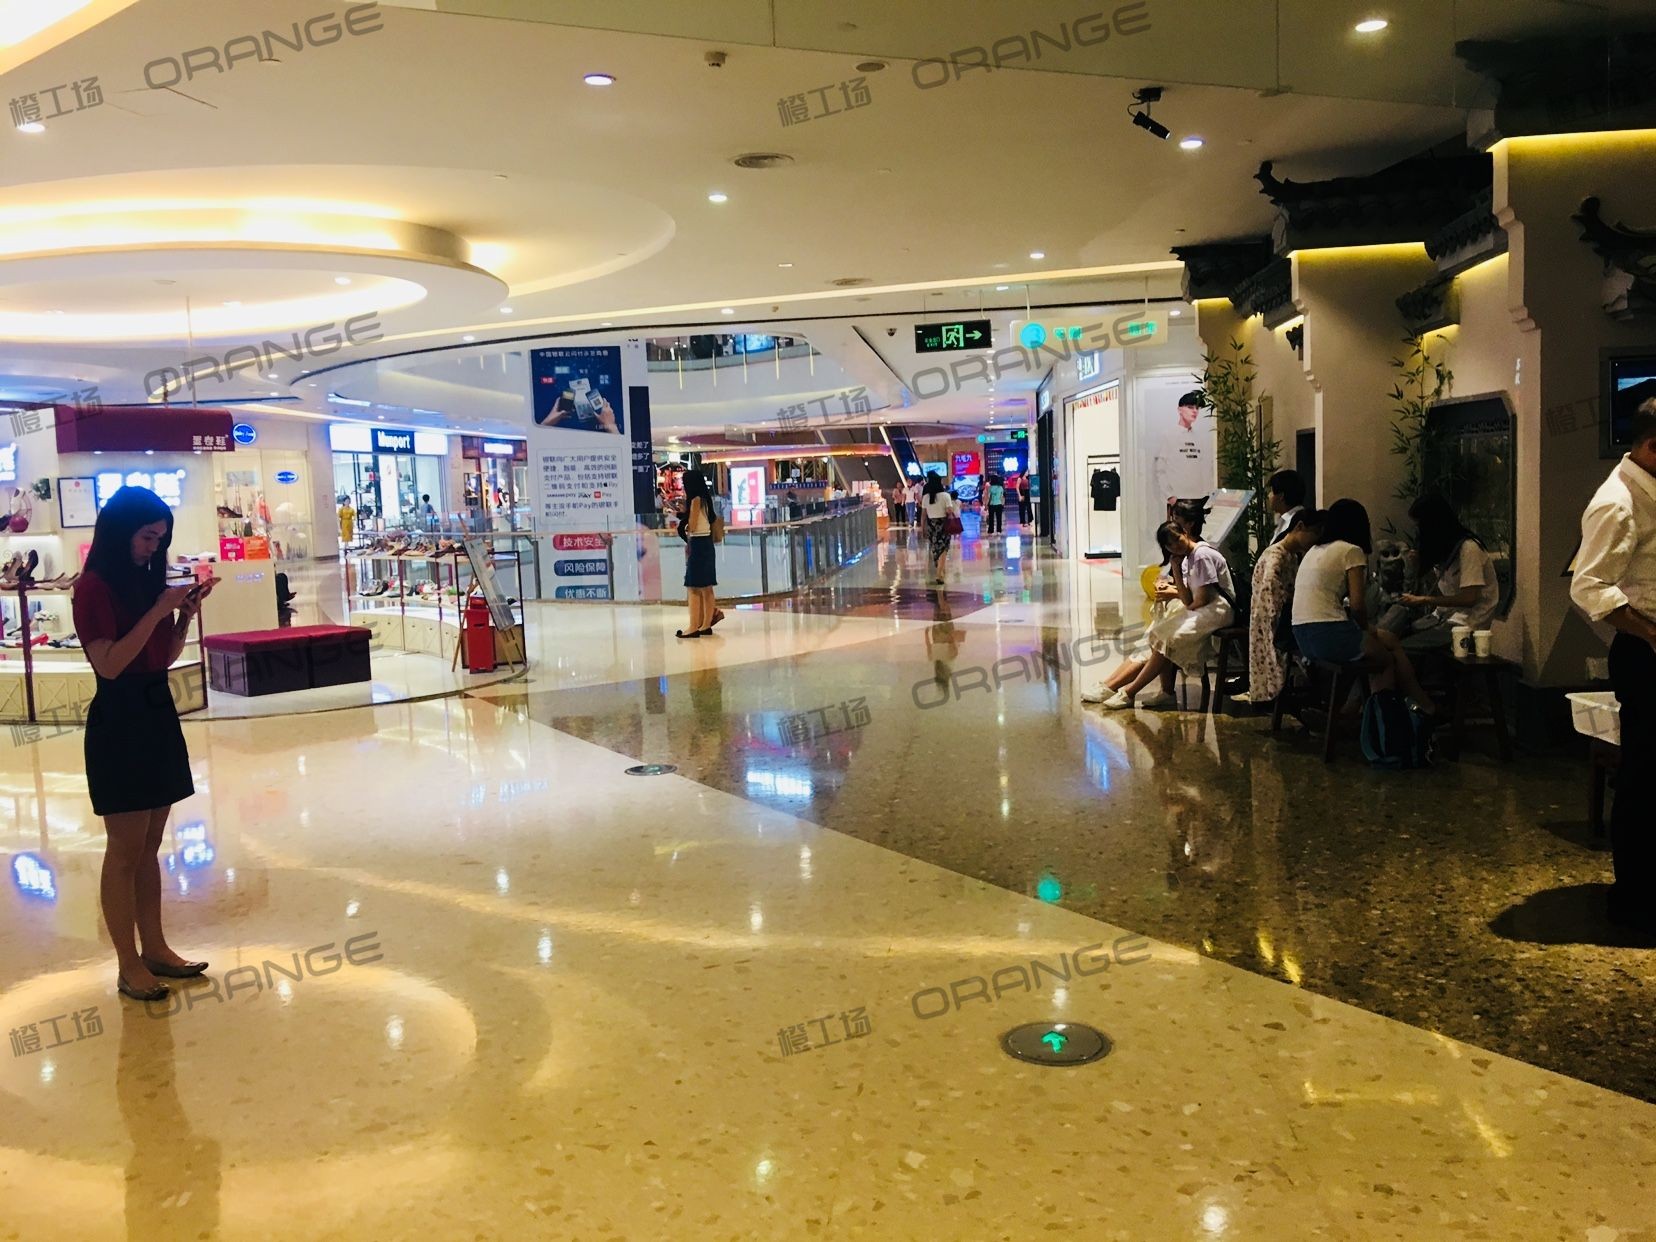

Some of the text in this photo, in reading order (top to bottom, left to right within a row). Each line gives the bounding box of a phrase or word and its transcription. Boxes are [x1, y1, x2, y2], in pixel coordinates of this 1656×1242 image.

[563, 536, 607, 547] 技术安全
[564, 562, 607, 573] 风险保障
[564, 588, 608, 599] 优惠不断
